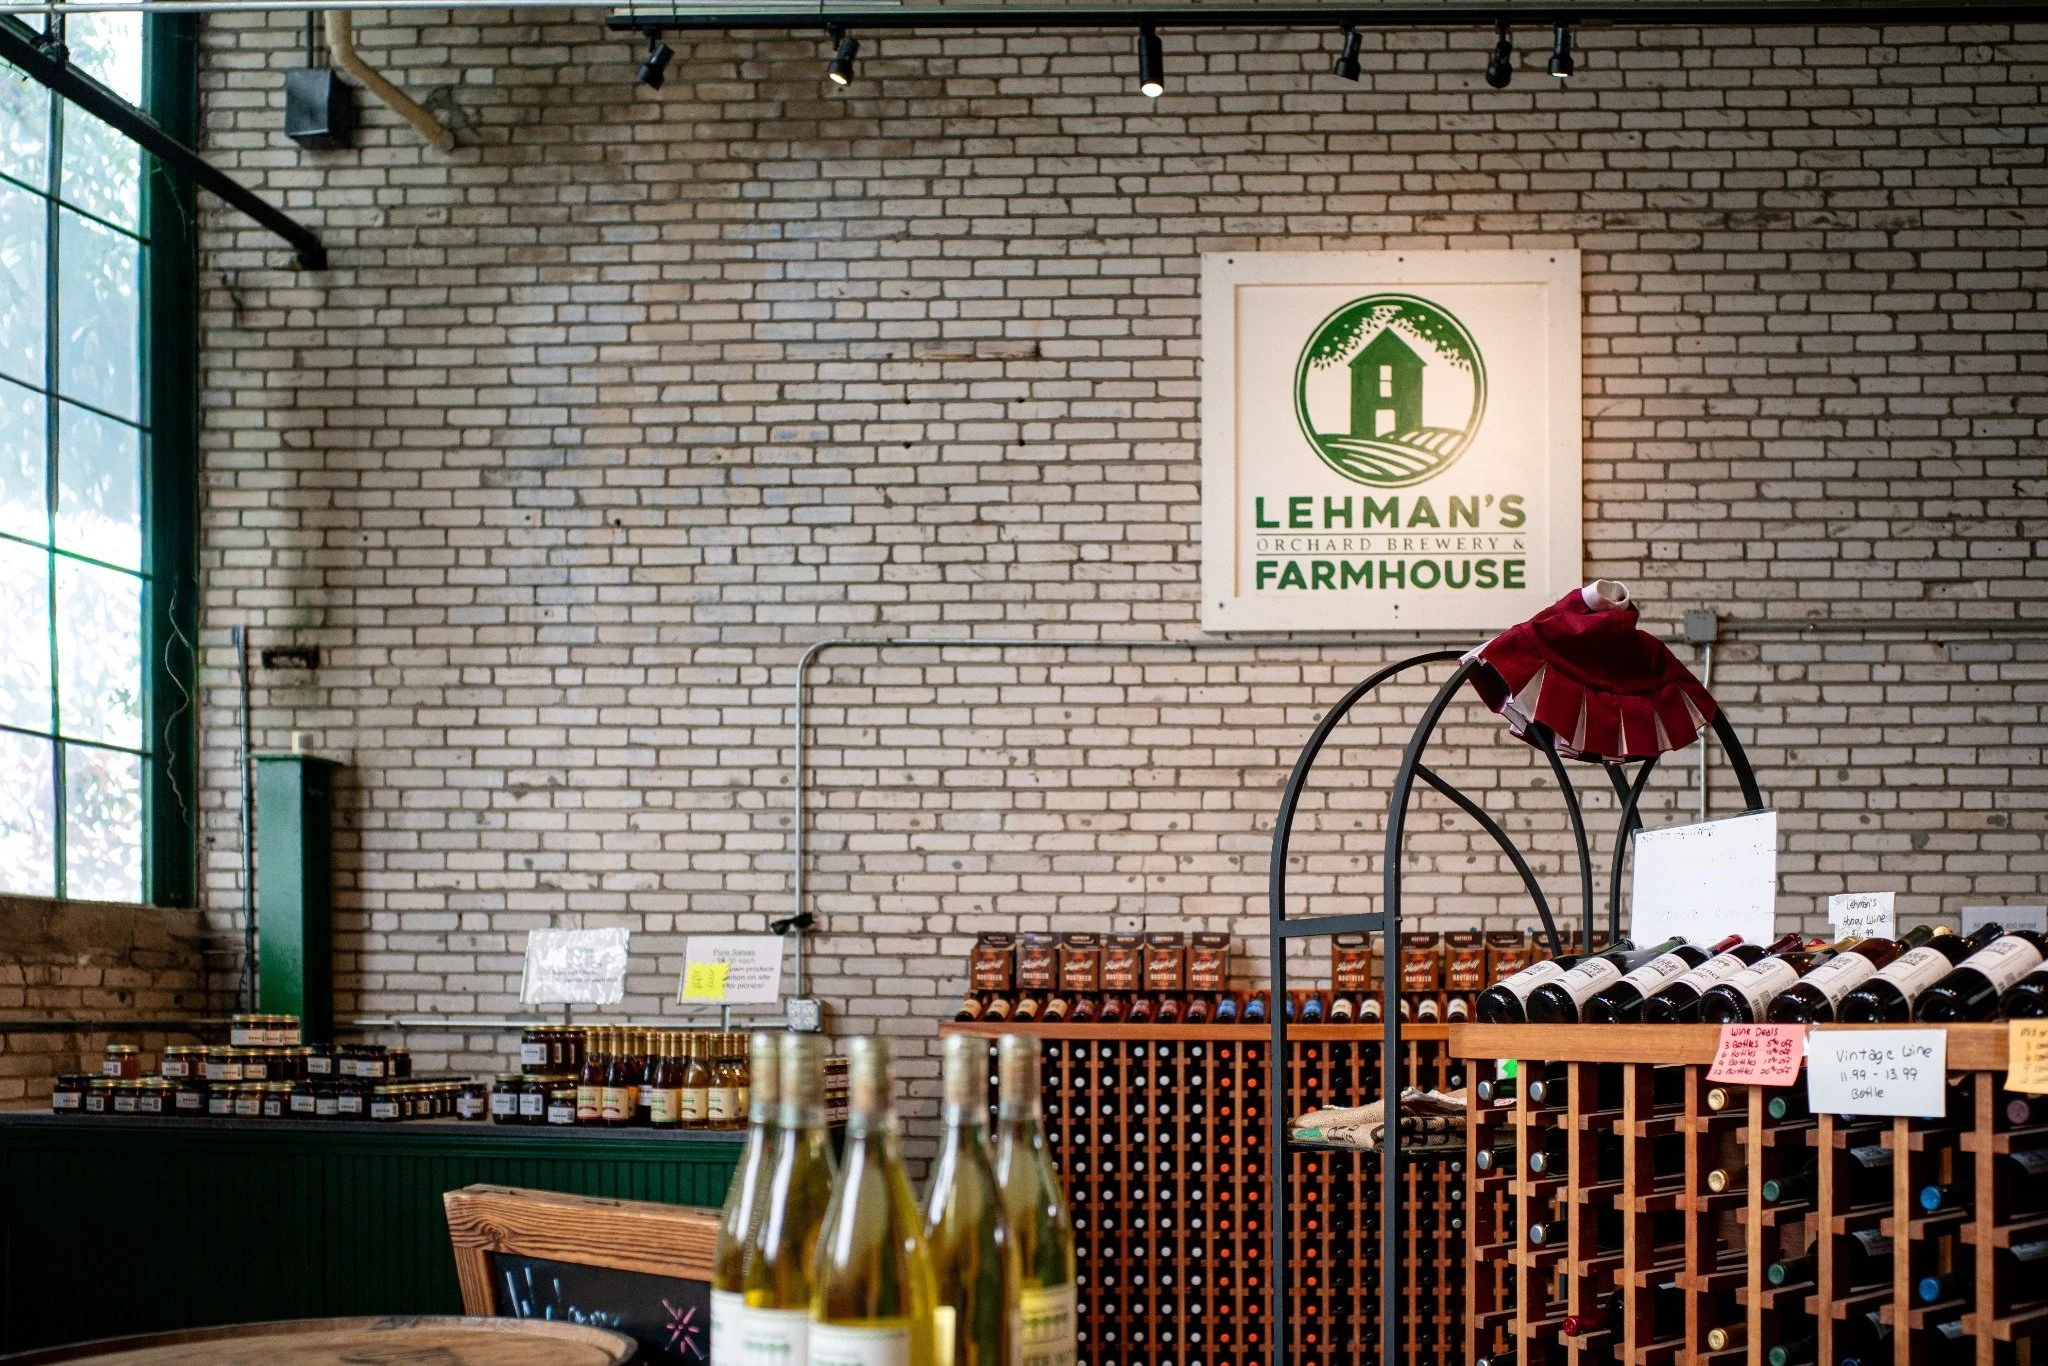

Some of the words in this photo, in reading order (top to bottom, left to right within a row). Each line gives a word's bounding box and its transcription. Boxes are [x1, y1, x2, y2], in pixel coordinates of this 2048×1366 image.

[1255, 494, 1527, 528] LEHMAN'S
[1256, 537, 1372, 552] ORCHARD
[1388, 537, 1500, 551] BREWERY
[1513, 537, 1525, 550] &
[1255, 559, 1527, 590] FARMHOUSE
[1843, 915, 1864, 927] Honey
[1866, 914, 1886, 925] Wine
[1731, 1028, 1751, 1037] Wine
[1755, 1027, 1779, 1037] Deals
[1724, 1041, 1730, 1049] 3
[1732, 1039, 1759, 1049] Bottles
[1731, 1049, 1756, 1058] Bottles
[1835, 1047, 1895, 1064] Vintage
[1902, 1046, 1934, 1059] Wine
[1728, 1058, 1756, 1066] Bottles
[1840, 1069, 1867, 1082] 11.99
[1885, 1068, 1918, 1081] 13.99
[1851, 1088, 1885, 1100] Bottle
